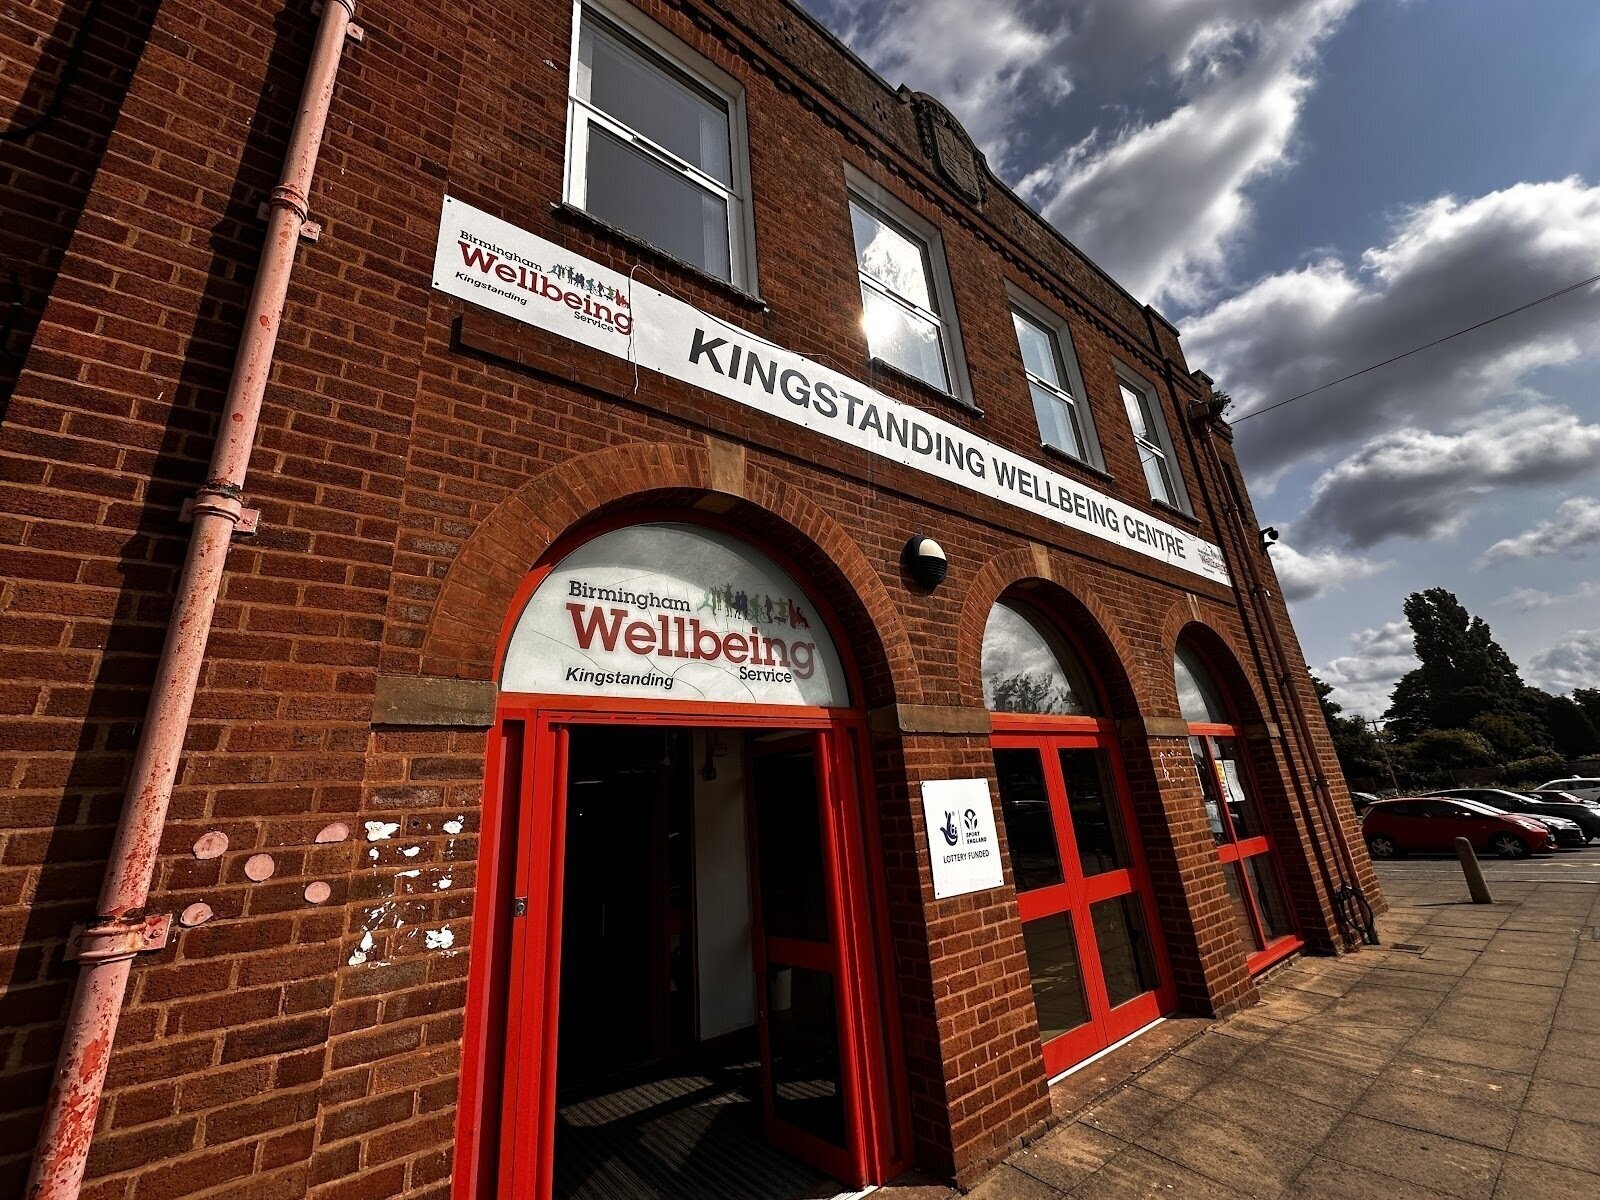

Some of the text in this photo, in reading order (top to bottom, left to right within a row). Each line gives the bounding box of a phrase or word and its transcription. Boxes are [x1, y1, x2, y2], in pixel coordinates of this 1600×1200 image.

[459, 229, 543, 272] Birmingham
[454, 270, 528, 306] Kingstanding
[457, 239, 634, 336] Wellbeing
[573, 310, 614, 333] Service
[688, 327, 1187, 560] KINGSTANDING WELLBEING CENTRE
[568, 580, 691, 613] Birmingham
[565, 602, 815, 679] Wellbeing
[565, 667, 674, 690] Kingstanding
[739, 665, 793, 684] Service
[943, 849, 990, 864] LOTTERY FUNDED
